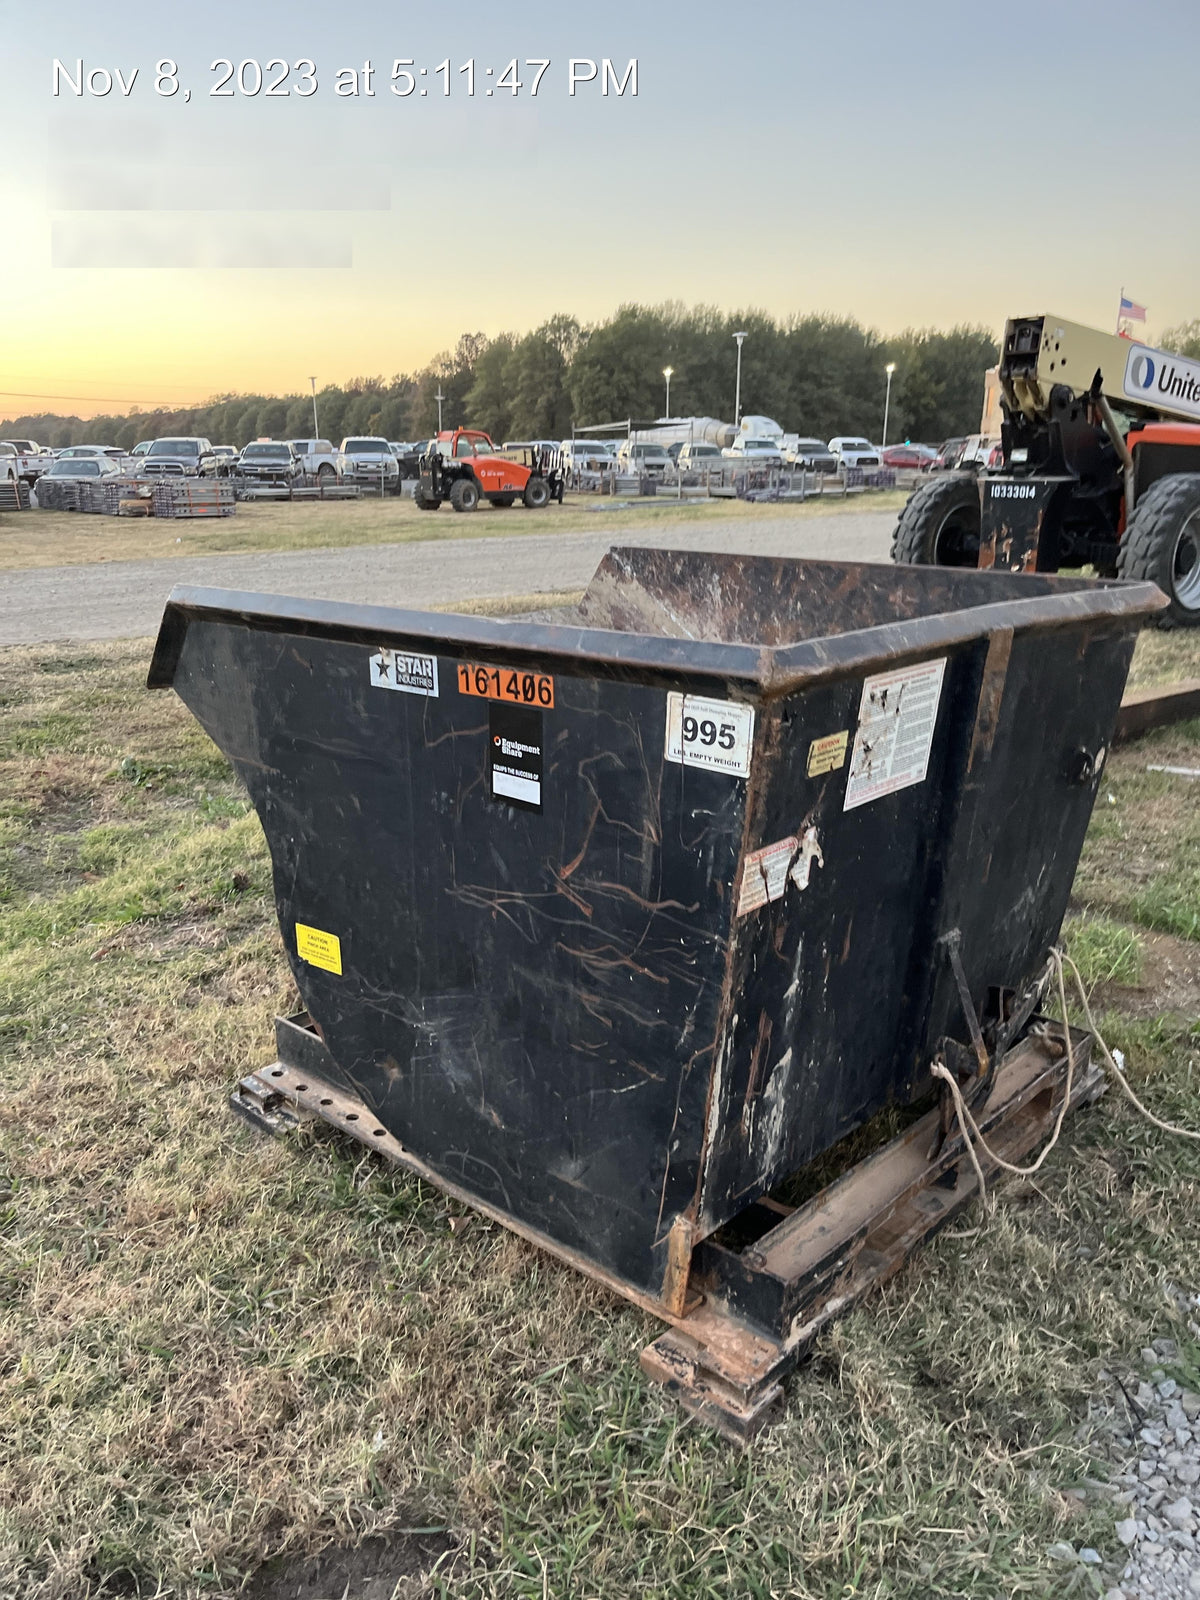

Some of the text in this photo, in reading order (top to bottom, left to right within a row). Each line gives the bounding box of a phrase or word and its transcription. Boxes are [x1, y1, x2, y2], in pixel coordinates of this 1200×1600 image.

[990, 484, 1036, 499] 10333014
[397, 656, 433, 678] STAR
[398, 674, 433, 688] INDUSTRIES
[461, 665, 552, 705] 161406
[683, 716, 736, 750] 995
[501, 738, 541, 755] Equipment
[501, 746, 523, 758] Share
[689, 752, 713, 762] EMPTY
[714, 757, 742, 768] WEIGHT
[507, 767, 515, 775] THE
[515, 769, 533, 780] SUCCESS
[307, 933, 329, 945] CAUTION
